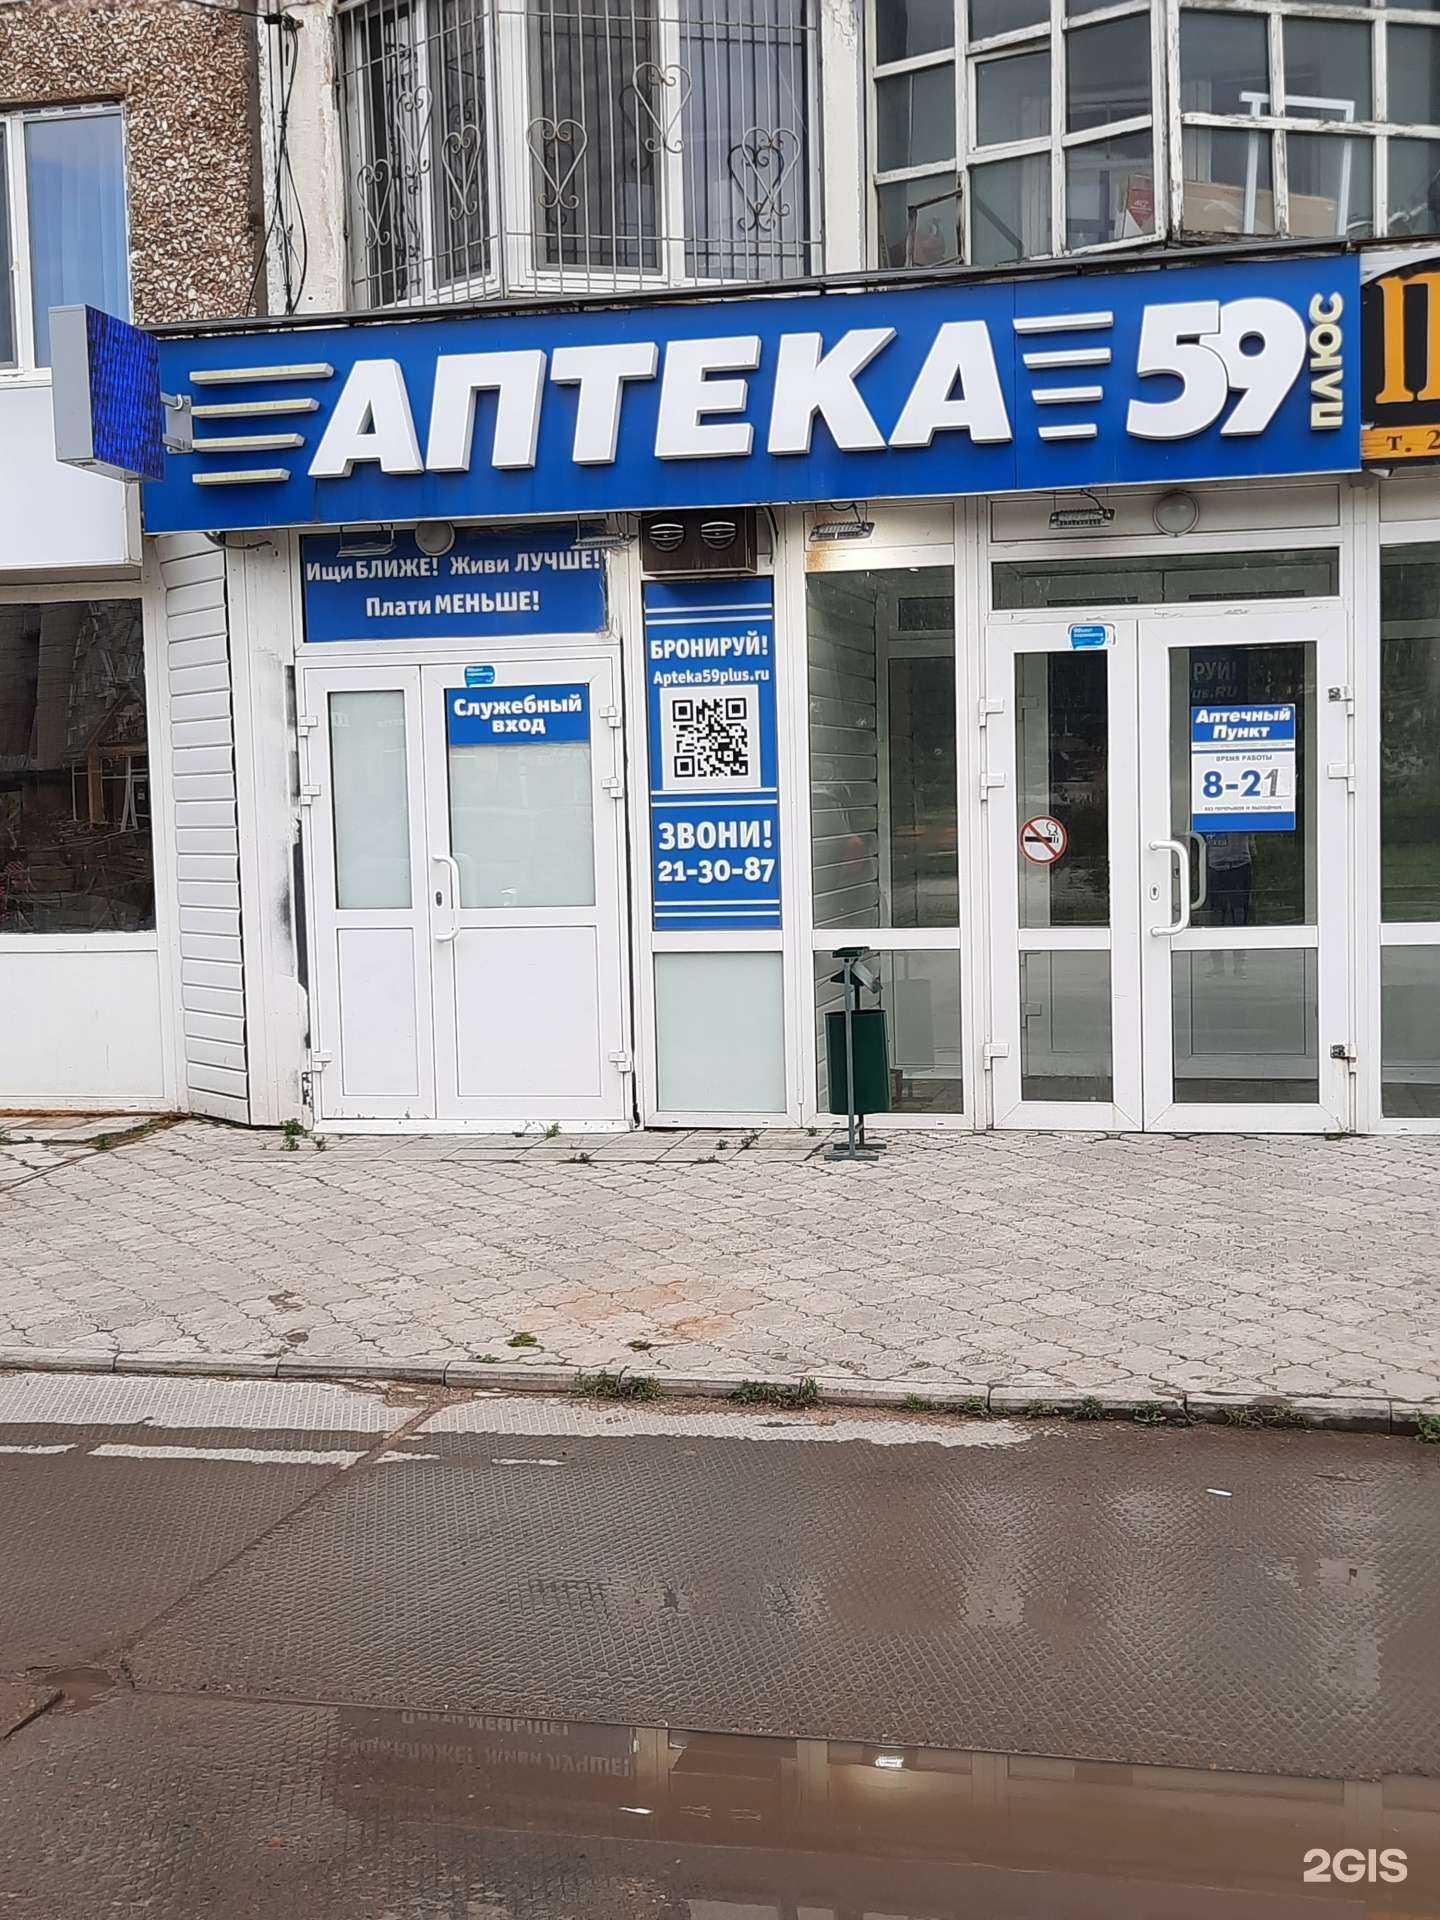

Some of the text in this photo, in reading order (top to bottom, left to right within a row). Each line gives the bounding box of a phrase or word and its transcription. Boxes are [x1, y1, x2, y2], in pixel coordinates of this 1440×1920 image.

[1308, 291, 1343, 431] ПЛЮС
[307, 297, 1306, 479] АПТЕКА 59
[306, 550, 600, 582] Ищи БЛИЖЕ! Живи ЛУЧШЕ!
[366, 590, 540, 617] Плати МЕНЬШЕ!
[650, 630, 768, 659] БРОНИРУЙ!
[653, 667, 769, 687] Apteka59plus.ru
[454, 694, 582, 719] Служебный
[1195, 707, 1291, 723] Аптечный
[492, 718, 546, 734] вход
[1213, 725, 1270, 740] Пункт
[1242, 753, 1272, 761] РАБОТЫ
[1202, 768, 1279, 799] 8-21
[658, 820, 772, 850] ЗВОНИ!
[658, 857, 775, 883] 21-30-87
